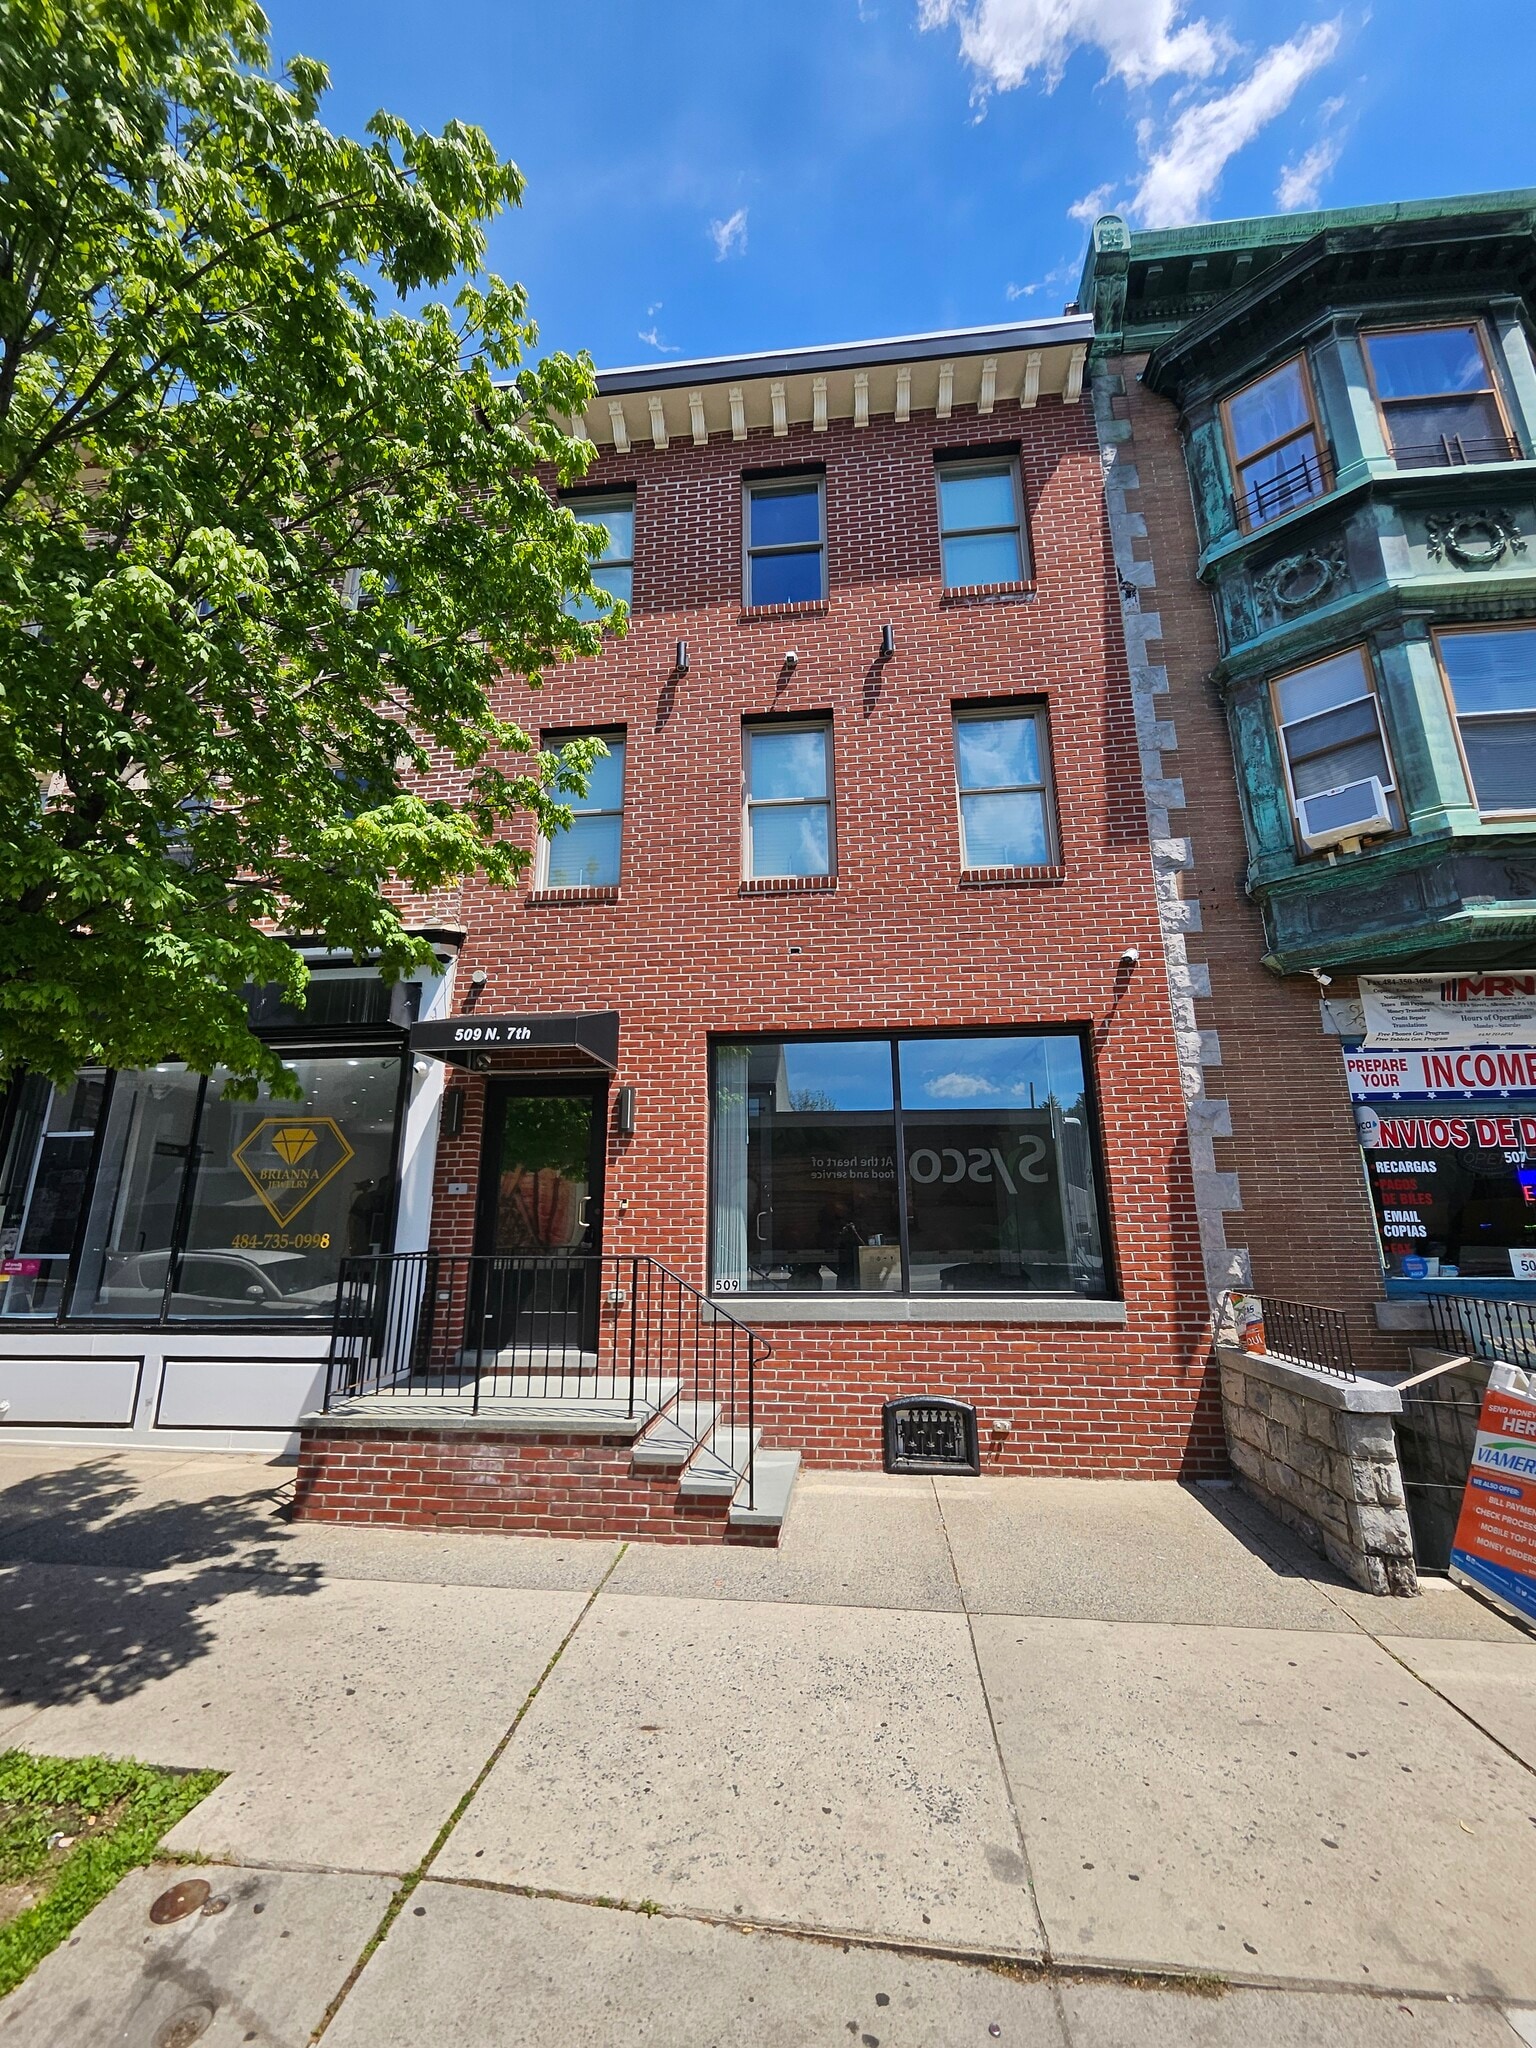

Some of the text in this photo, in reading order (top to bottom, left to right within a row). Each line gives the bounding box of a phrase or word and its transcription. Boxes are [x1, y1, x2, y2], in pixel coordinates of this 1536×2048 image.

[1457, 976, 1535, 1001] MRN
[1460, 1014, 1483, 1022] Hours
[1492, 1013, 1533, 1022] Operations
[454, 1026, 532, 1041] 509 N. 7th
[1347, 1058, 1408, 1073] PREPARE
[1421, 1053, 1536, 1088] INCOME
[1360, 1073, 1400, 1088] YOUR
[1374, 1117, 1470, 1149] NVIOS
[1474, 1117, 1519, 1149] DE
[1463, 1151, 1502, 1166] OPE
[1503, 1151, 1526, 1164] 507
[260, 1168, 320, 1180] BRIANNA
[1375, 1160, 1437, 1174] RECARGAS
[268, 1180, 309, 1190] JEWELRY
[1379, 1178, 1418, 1191] PAGOS
[1382, 1193, 1397, 1205] DE
[1383, 1210, 1421, 1223] EMAIL
[1383, 1225, 1427, 1238] COPIAS
[231, 1233, 330, 1249] 484-735-0998
[1391, 1243, 1414, 1255] FAX
[715, 1279, 739, 1291] 509
[1488, 1404, 1536, 1418] SEND MONEY
[1502, 1416, 1536, 1437] HER
[1477, 1447, 1536, 1475] VIAMER
[1473, 1478, 1520, 1496] WE ALSO OFFER:
[1488, 1496, 1504, 1507] BILL
[1475, 1506, 1501, 1521] CHECK
[1481, 1522, 1509, 1538] MOBILE
[1510, 1531, 1527, 1543] TOP
[1476, 1536, 1505, 1552] MONEY
